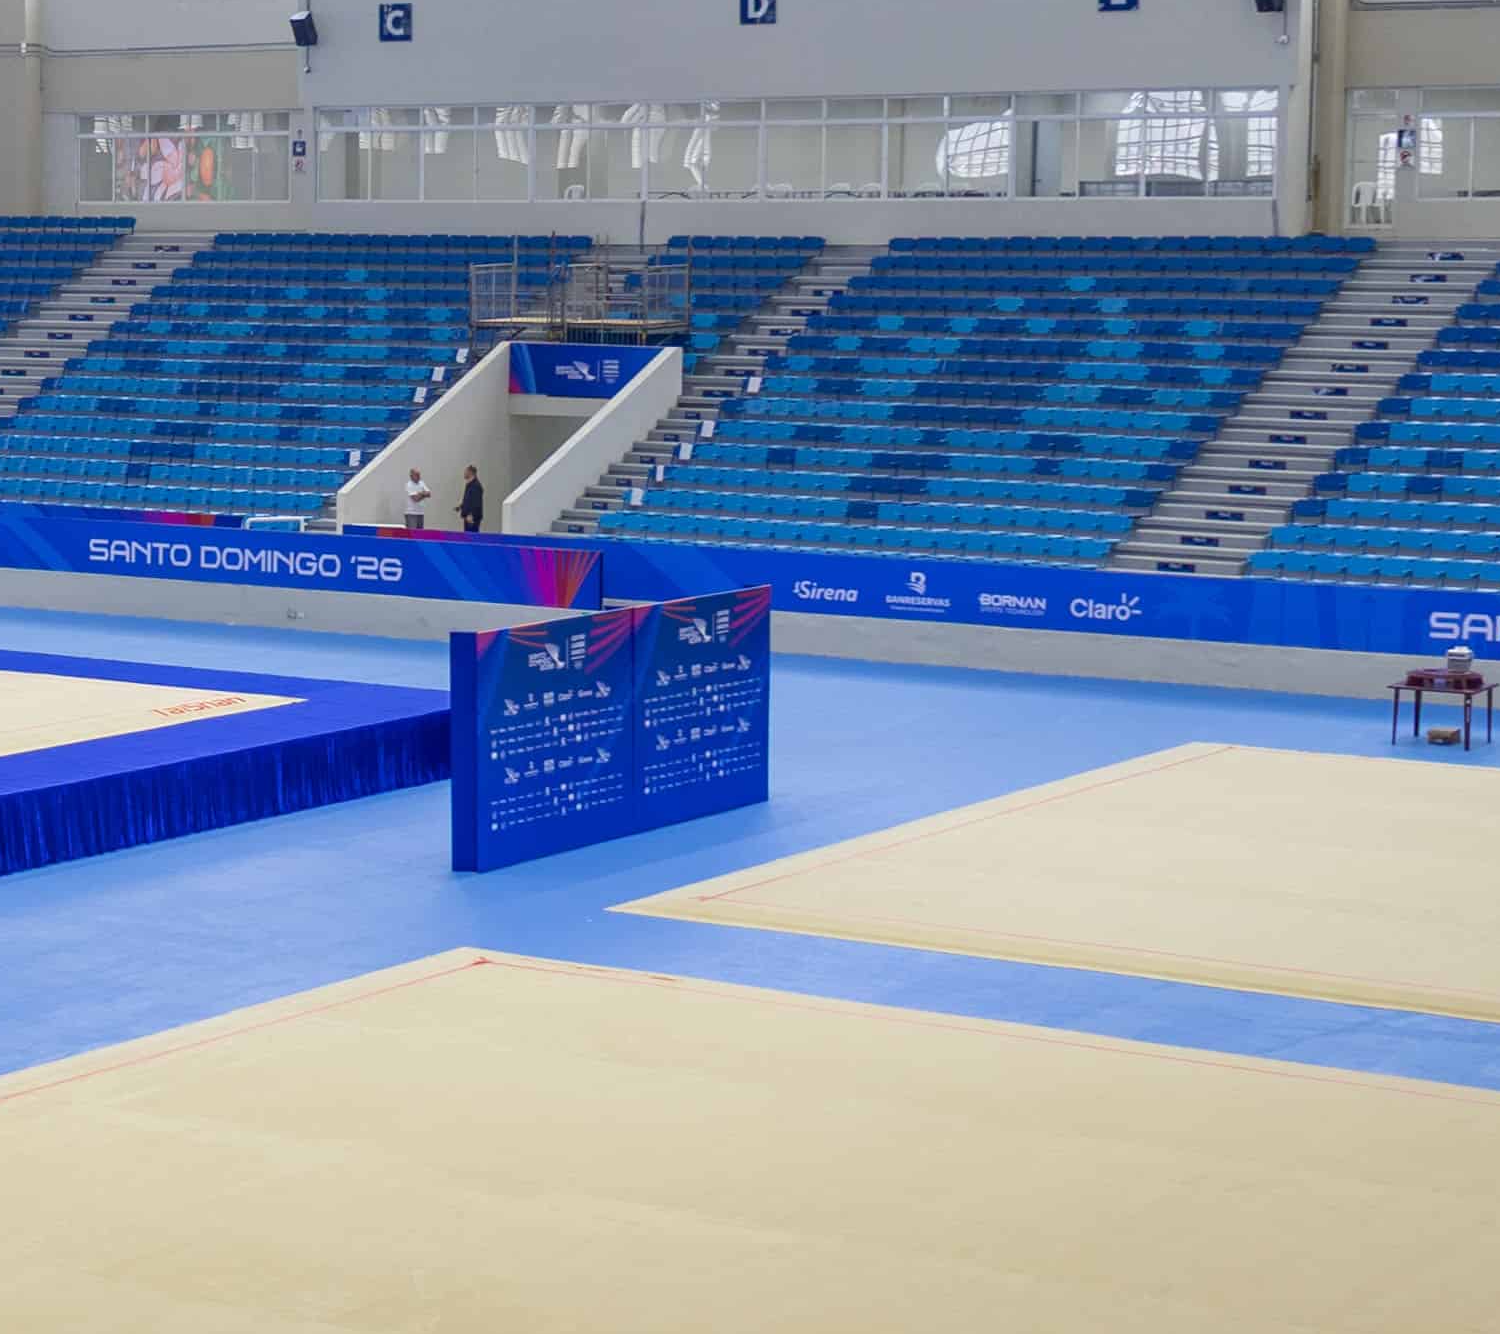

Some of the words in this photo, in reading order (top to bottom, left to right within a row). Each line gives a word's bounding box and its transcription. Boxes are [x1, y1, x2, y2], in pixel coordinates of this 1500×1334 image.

[386, 10, 404, 36] C
[89, 539, 191, 566] SANTO
[200, 546, 341, 578] DOMINGO
[798, 580, 859, 603] Sirena
[978, 592, 1047, 611] BORNAN
[1069, 594, 1132, 621] Claro
